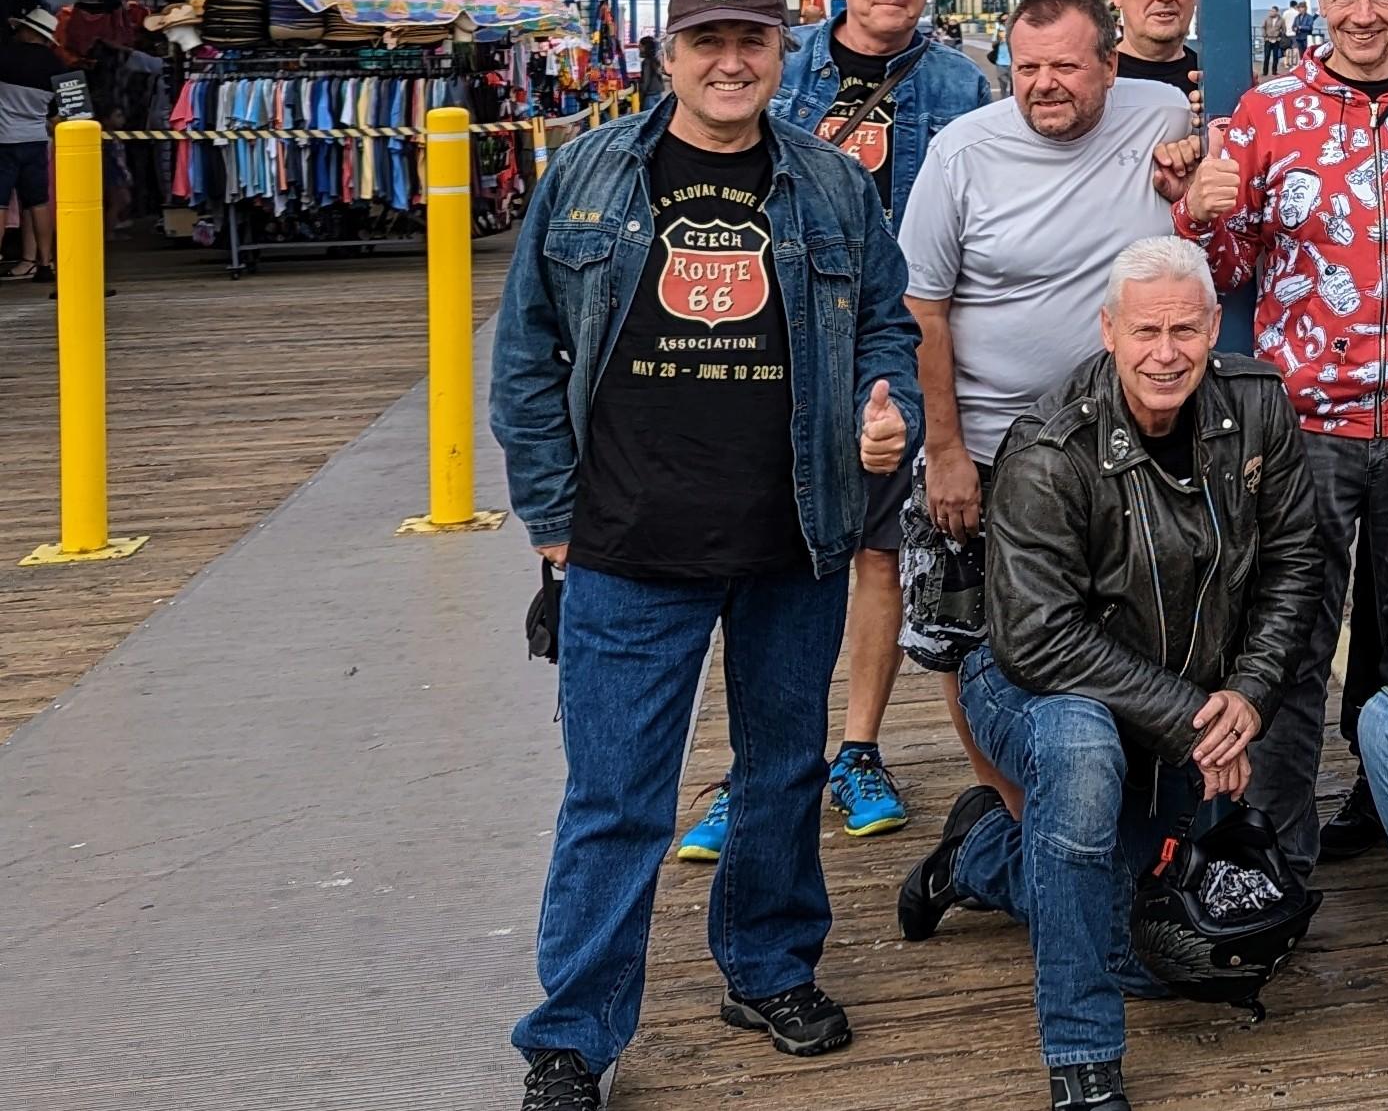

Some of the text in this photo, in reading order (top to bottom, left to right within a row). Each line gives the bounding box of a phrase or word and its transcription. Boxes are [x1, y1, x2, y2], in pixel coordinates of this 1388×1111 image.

[1265, 94, 1326, 137] 13
[661, 196, 672, 208] &
[673, 184, 717, 202] SLOVAK
[721, 187, 758, 207] ROUTE
[683, 230, 742, 248] CZECH
[673, 256, 751, 284] ROUTE
[687, 285, 734, 313] 66
[658, 336, 757, 351] ASSOCIATION
[632, 360, 655, 377] MAY
[660, 363, 676, 377] 26
[696, 363, 728, 380] JUNE
[733, 364, 747, 380] 10
[752, 364, 784, 380] 2023
